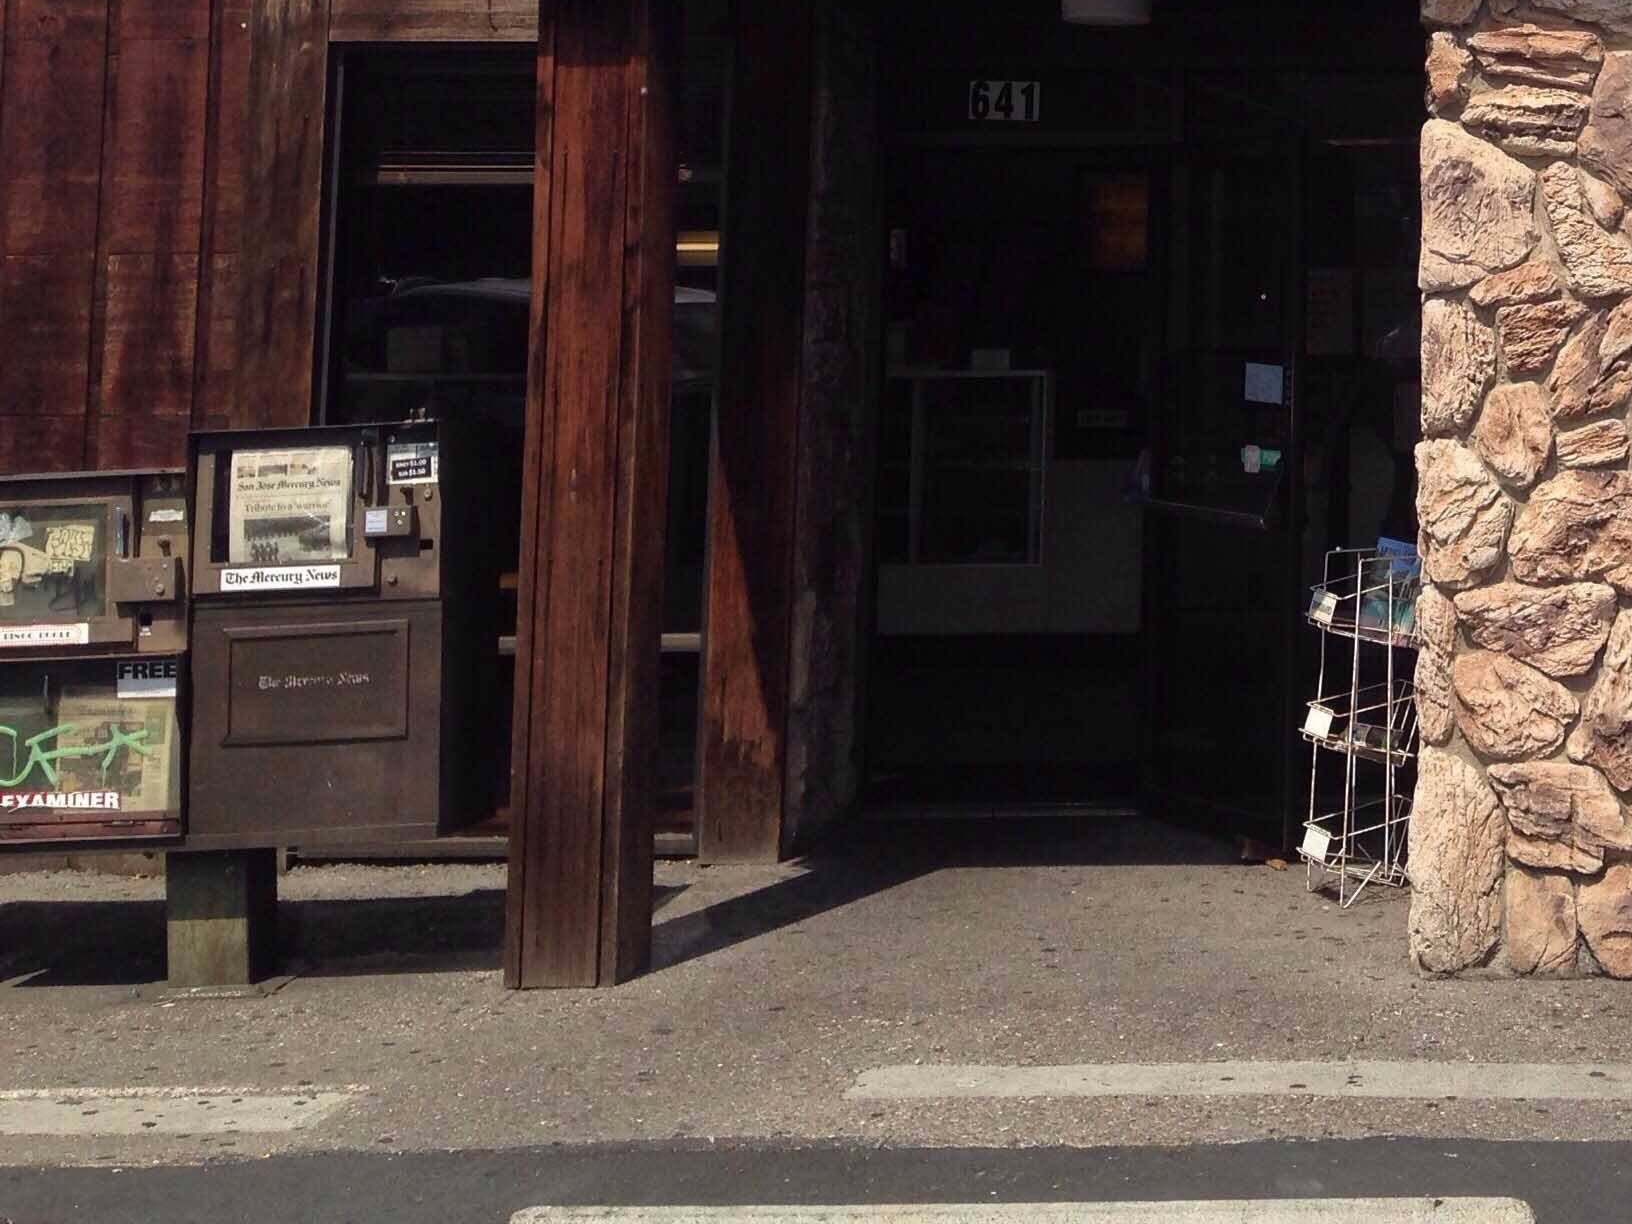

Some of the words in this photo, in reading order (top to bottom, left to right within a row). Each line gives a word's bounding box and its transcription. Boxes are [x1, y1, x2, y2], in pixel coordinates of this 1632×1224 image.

[971, 80, 1036, 120] 641
[316, 477, 342, 488] News
[225, 572, 248, 585] The
[248, 570, 303, 585] Mercury
[305, 568, 338, 582] News
[118, 662, 176, 680] FREE
